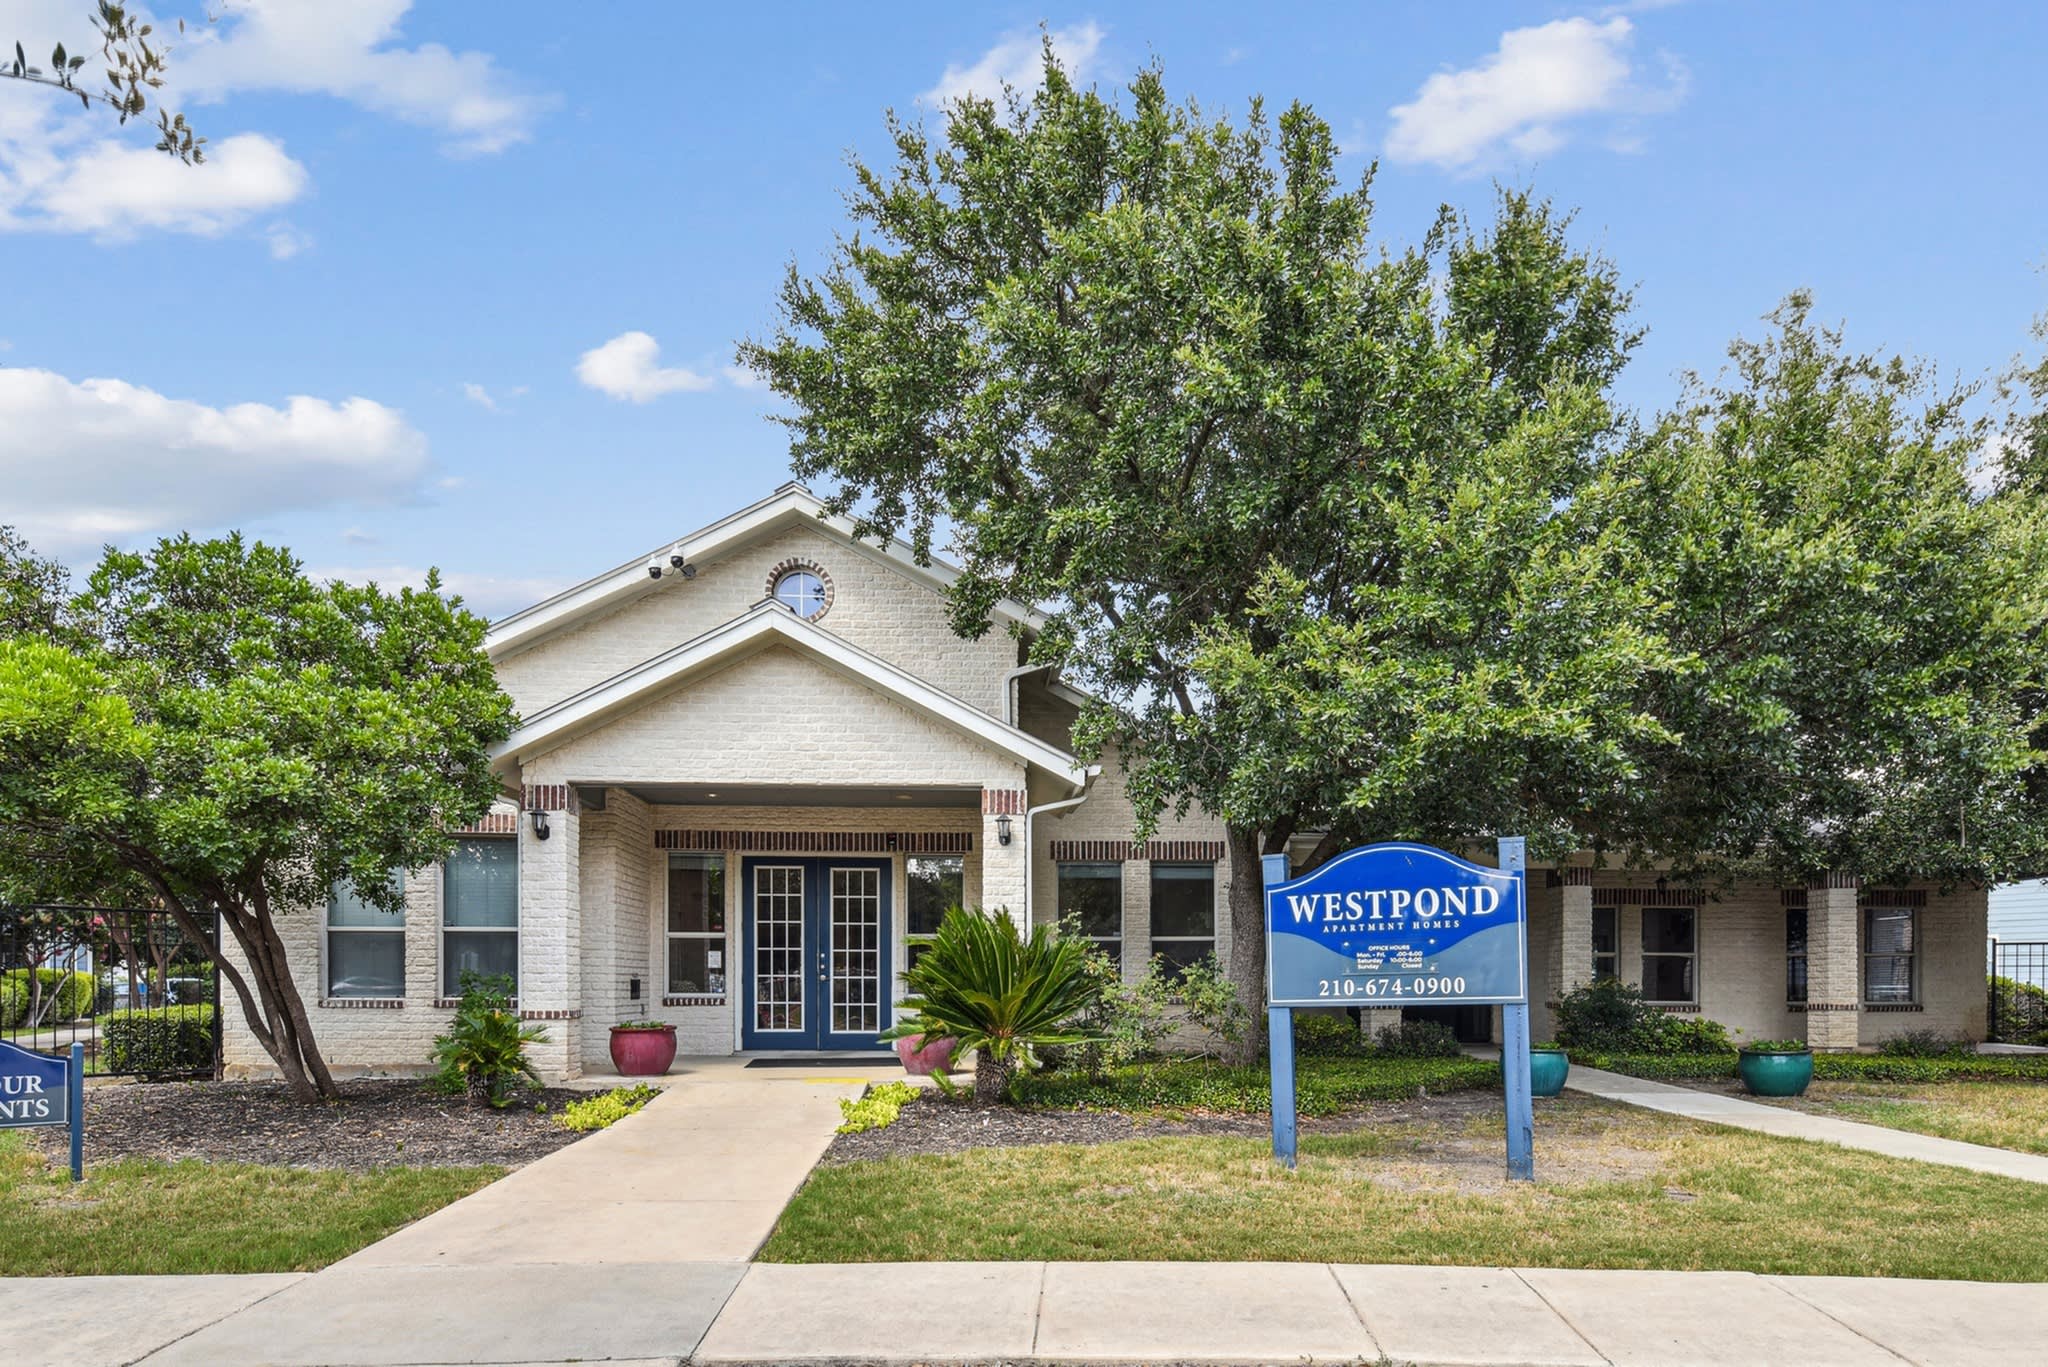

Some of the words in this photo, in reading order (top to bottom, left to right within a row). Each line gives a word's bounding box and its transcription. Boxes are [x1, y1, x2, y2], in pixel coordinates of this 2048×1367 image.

[1287, 885, 1499, 923] WESTPOND
[1323, 922, 1404, 933] APARTMENT
[1412, 920, 1460, 929] HOMES
[1319, 976, 1466, 996] 210-674-0900
[0, 1075, 44, 1094] UR
